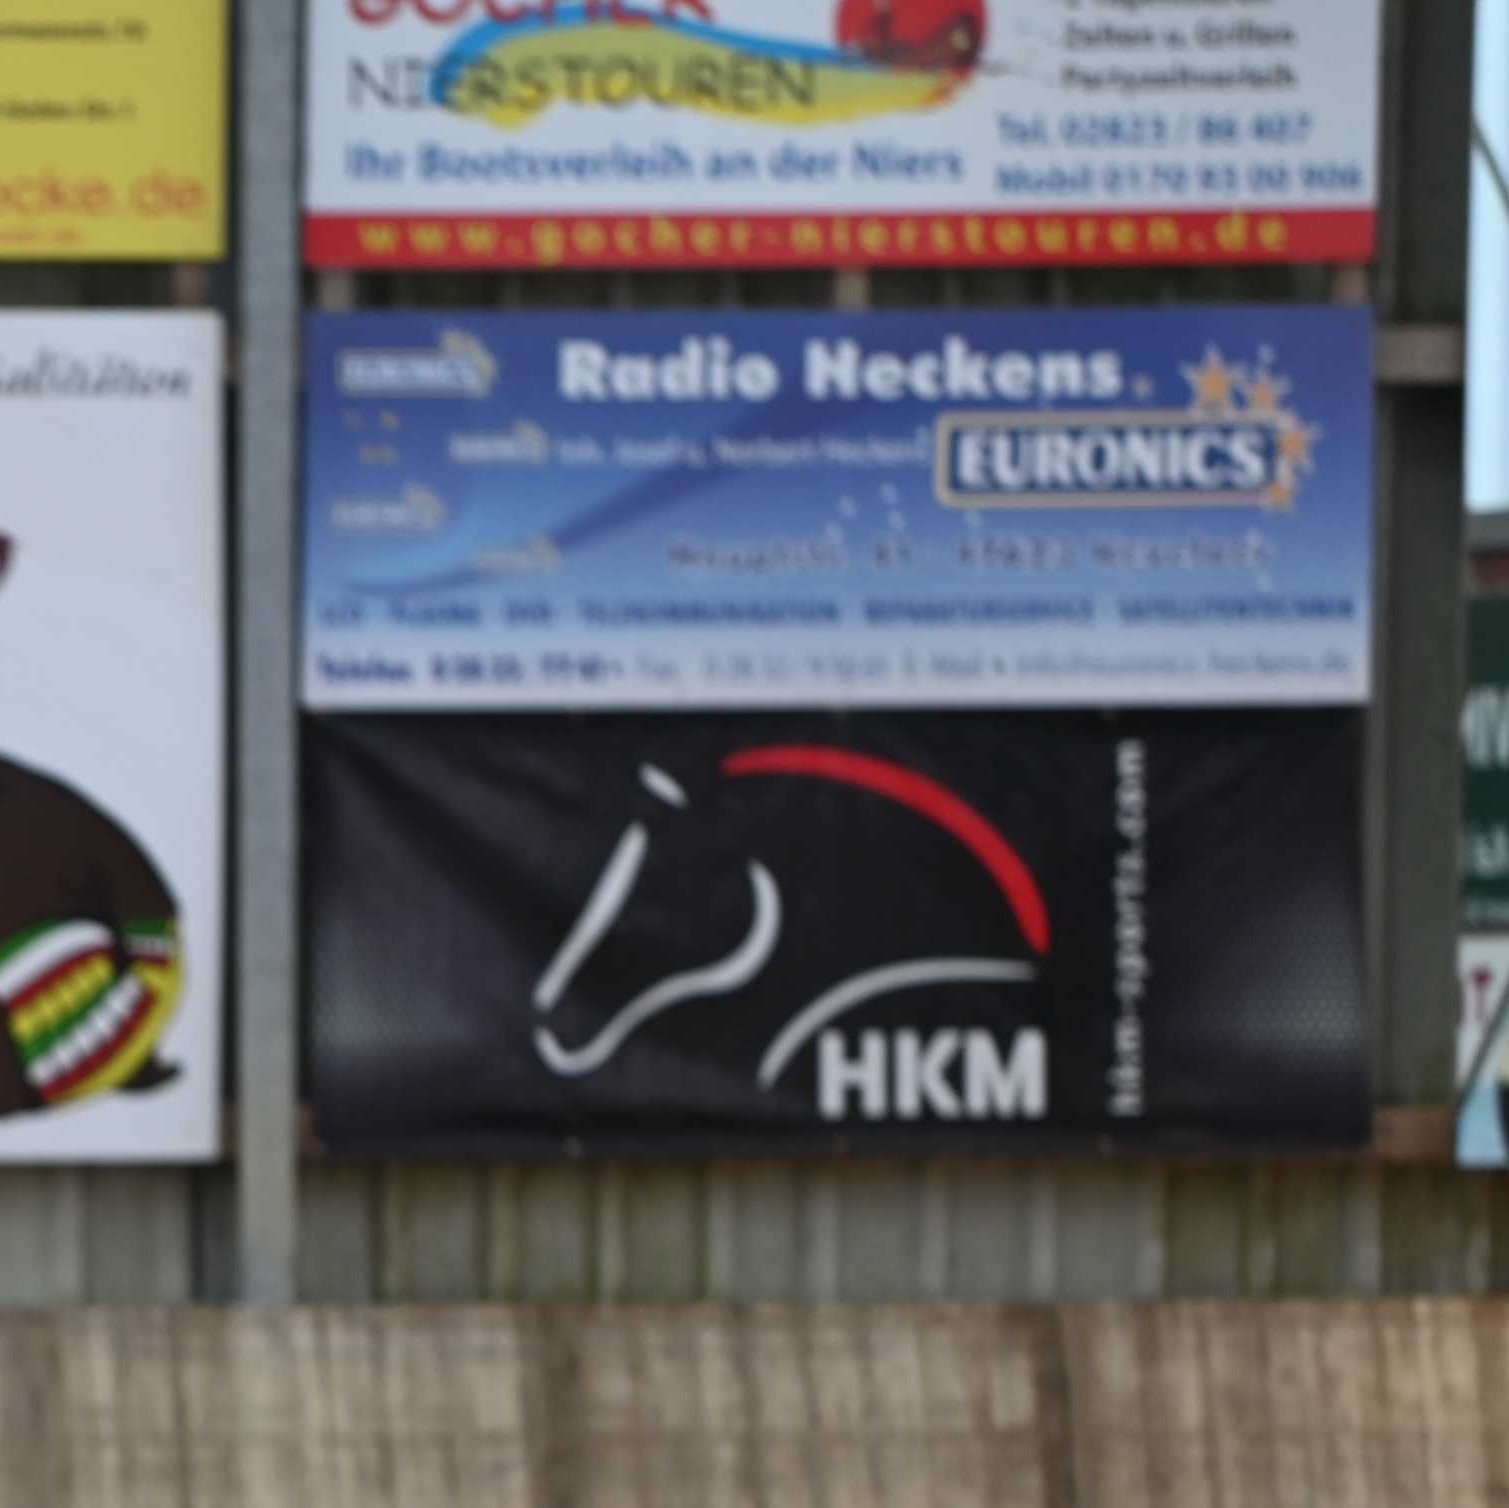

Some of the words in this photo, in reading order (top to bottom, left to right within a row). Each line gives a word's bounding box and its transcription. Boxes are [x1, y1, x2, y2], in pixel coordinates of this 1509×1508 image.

[347, 53, 819, 113] NIERSTOUREN
[345, 142, 406, 182] Ihr
[417, 141, 696, 182] Bootsverleih
[705, 153, 758, 182] an
[768, 141, 840, 183] der
[852, 141, 967, 183] Niers
[357, 212, 1289, 267] www.gocher-nierstouren.de
[557, 334, 781, 401] Radio
[803, 333, 1125, 401] Heckens
[953, 425, 1267, 490] EURONICS
[816, 1026, 1049, 1120] HKM
